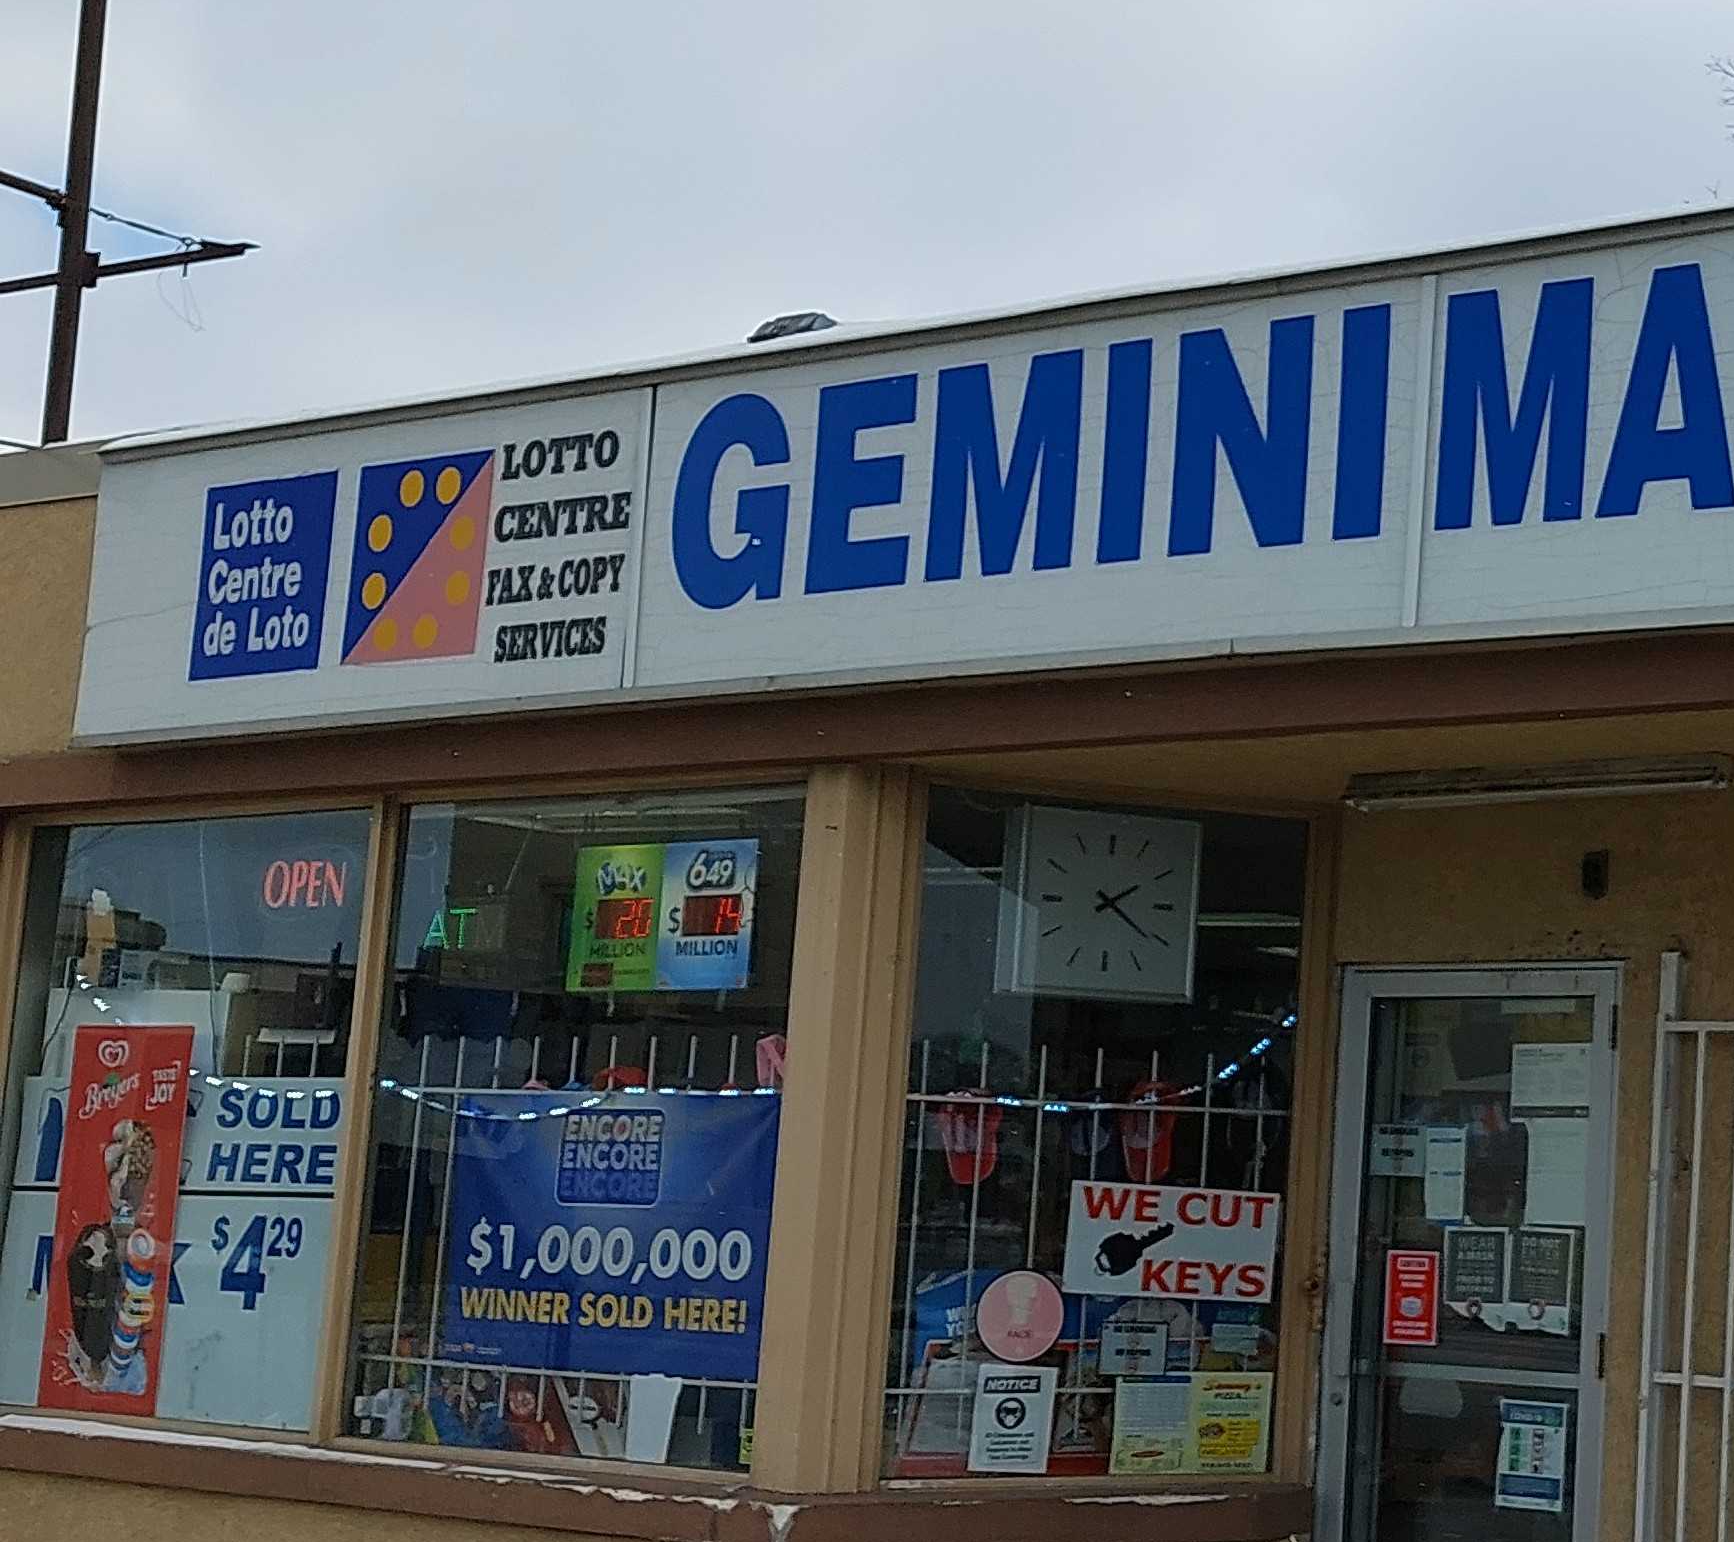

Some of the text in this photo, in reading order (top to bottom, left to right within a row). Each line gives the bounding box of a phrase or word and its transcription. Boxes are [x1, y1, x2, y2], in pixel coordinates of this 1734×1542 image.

[500, 430, 619, 480] LOTTO
[672, 304, 1391, 610] GEMINI
[213, 497, 293, 551] Lotto
[494, 492, 632, 542] CENTRE
[207, 557, 302, 605] Centre
[557, 553, 625, 597] COPY
[203, 606, 309, 657] de Loto
[494, 616, 607, 663] SERVICES
[264, 860, 347, 909] OPEN
[590, 940, 648, 958] MILLION
[676, 939, 738, 956] MILLION
[79, 1072, 141, 1119] Breyers
[150, 1083, 176, 1104] JOY
[216, 1088, 341, 1129] SOLD
[564, 1114, 664, 1142] ENCORE
[206, 1143, 338, 1184] HERE
[561, 1143, 659, 1171] ENCORE
[1084, 1186, 1273, 1228] WE CUT
[466, 1217, 752, 1284] $1,000,000
[1141, 1259, 1265, 1297] KEYS
[460, 1286, 747, 1333] WINNER SOLD HERE!
[986, 1378, 1040, 1392] NOTICE
